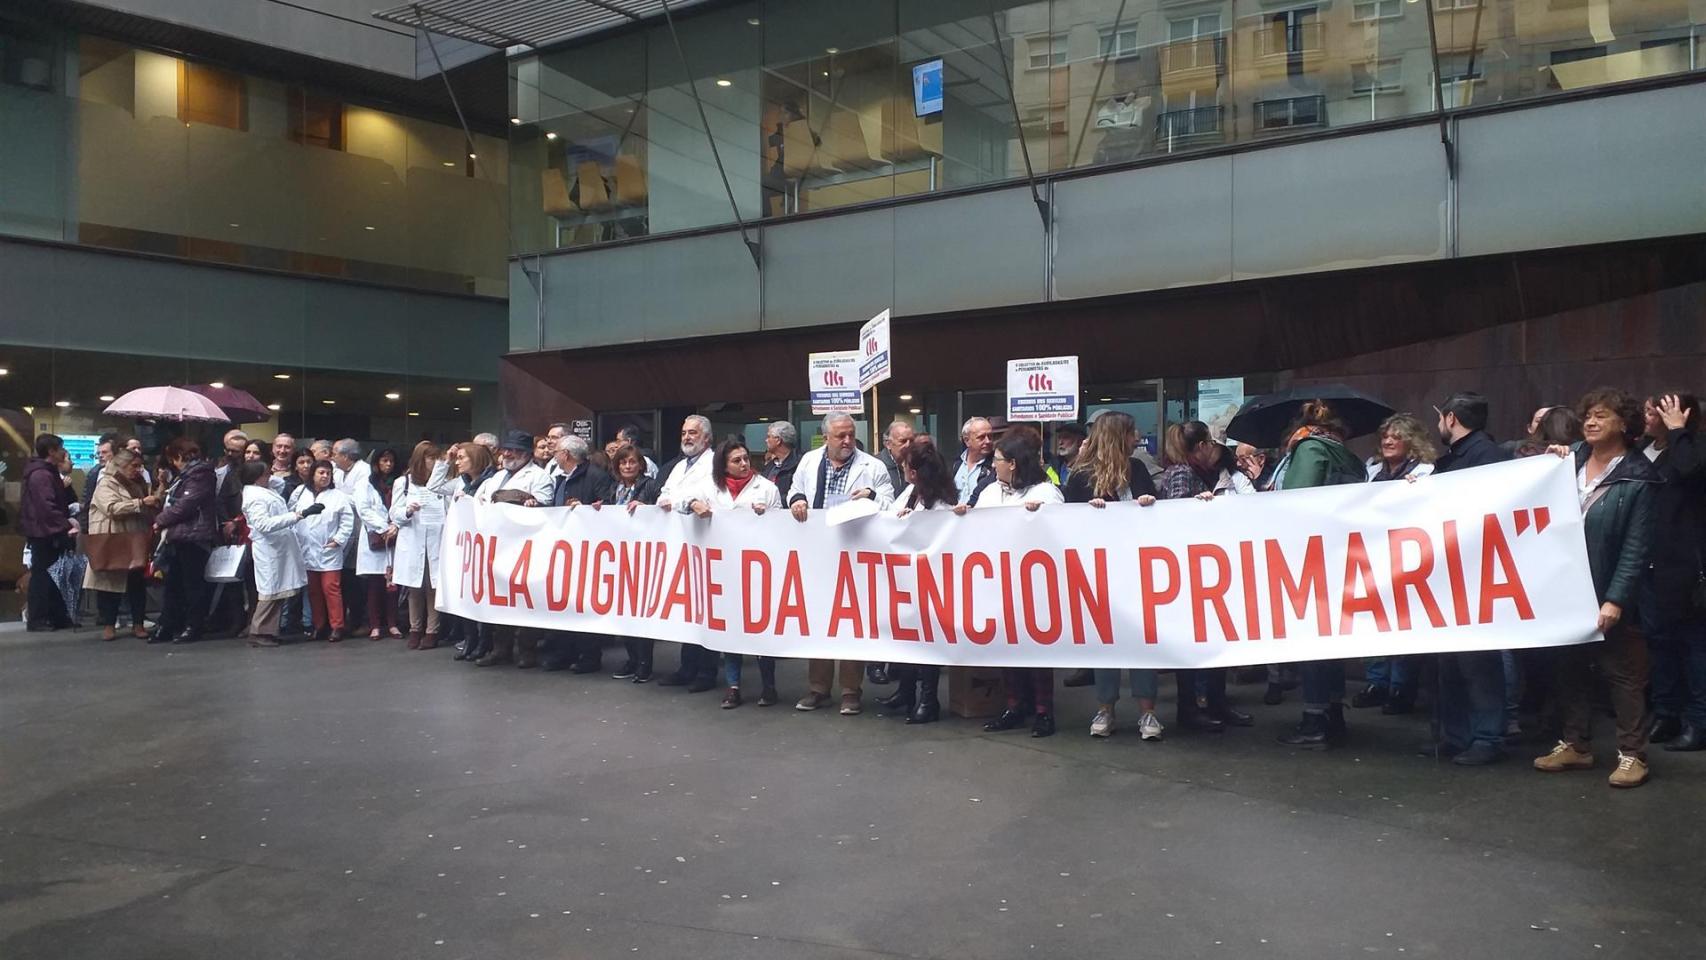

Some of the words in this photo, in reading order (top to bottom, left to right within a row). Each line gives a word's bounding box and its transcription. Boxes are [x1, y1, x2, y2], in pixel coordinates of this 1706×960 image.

[824, 370, 844, 386] CIG
[1028, 373, 1053, 391] CIG
[545, 539, 727, 632] DIGNIDADE
[741, 548, 810, 637] DA
[827, 547, 1114, 646] ATENCION
